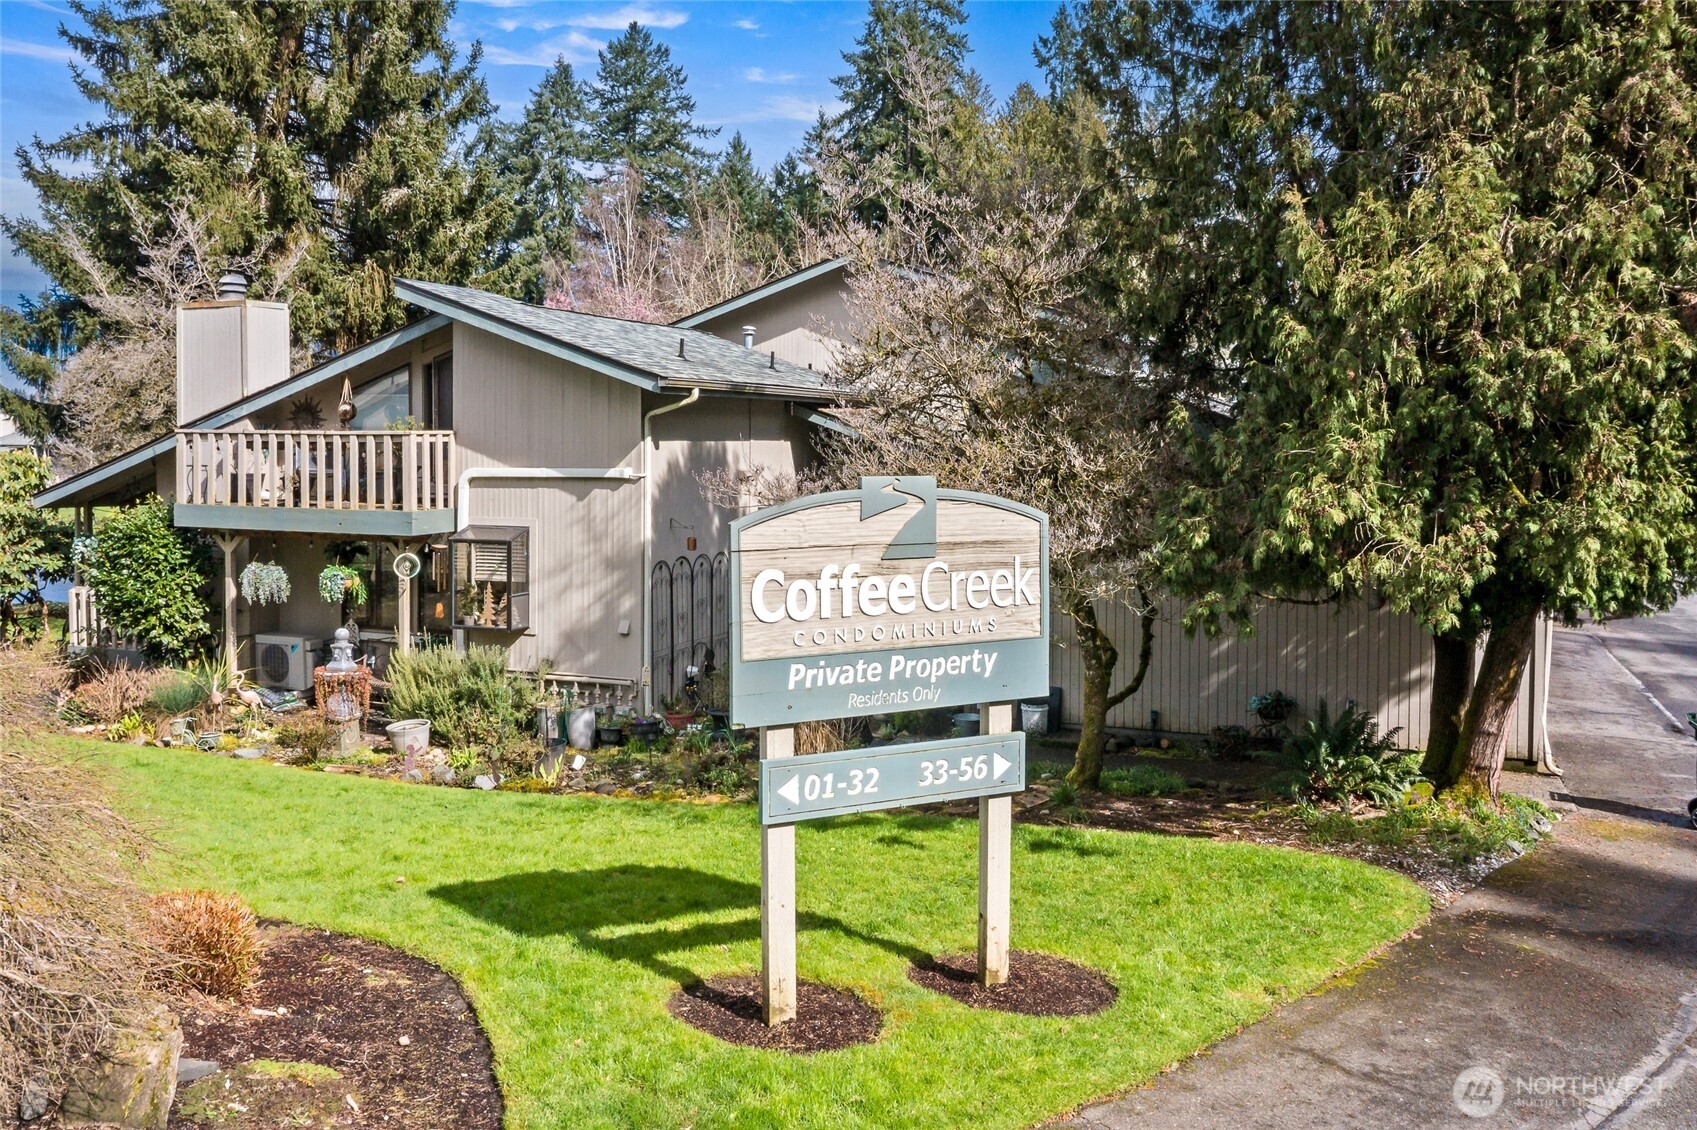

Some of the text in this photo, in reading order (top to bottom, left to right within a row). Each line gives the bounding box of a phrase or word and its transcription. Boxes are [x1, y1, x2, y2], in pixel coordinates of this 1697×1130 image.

[793, 617, 998, 647] CONDOMINIUMS
[788, 649, 998, 690] Private Property
[848, 685, 941, 709] Residents Only
[804, 754, 988, 801] 01-32 33-56
